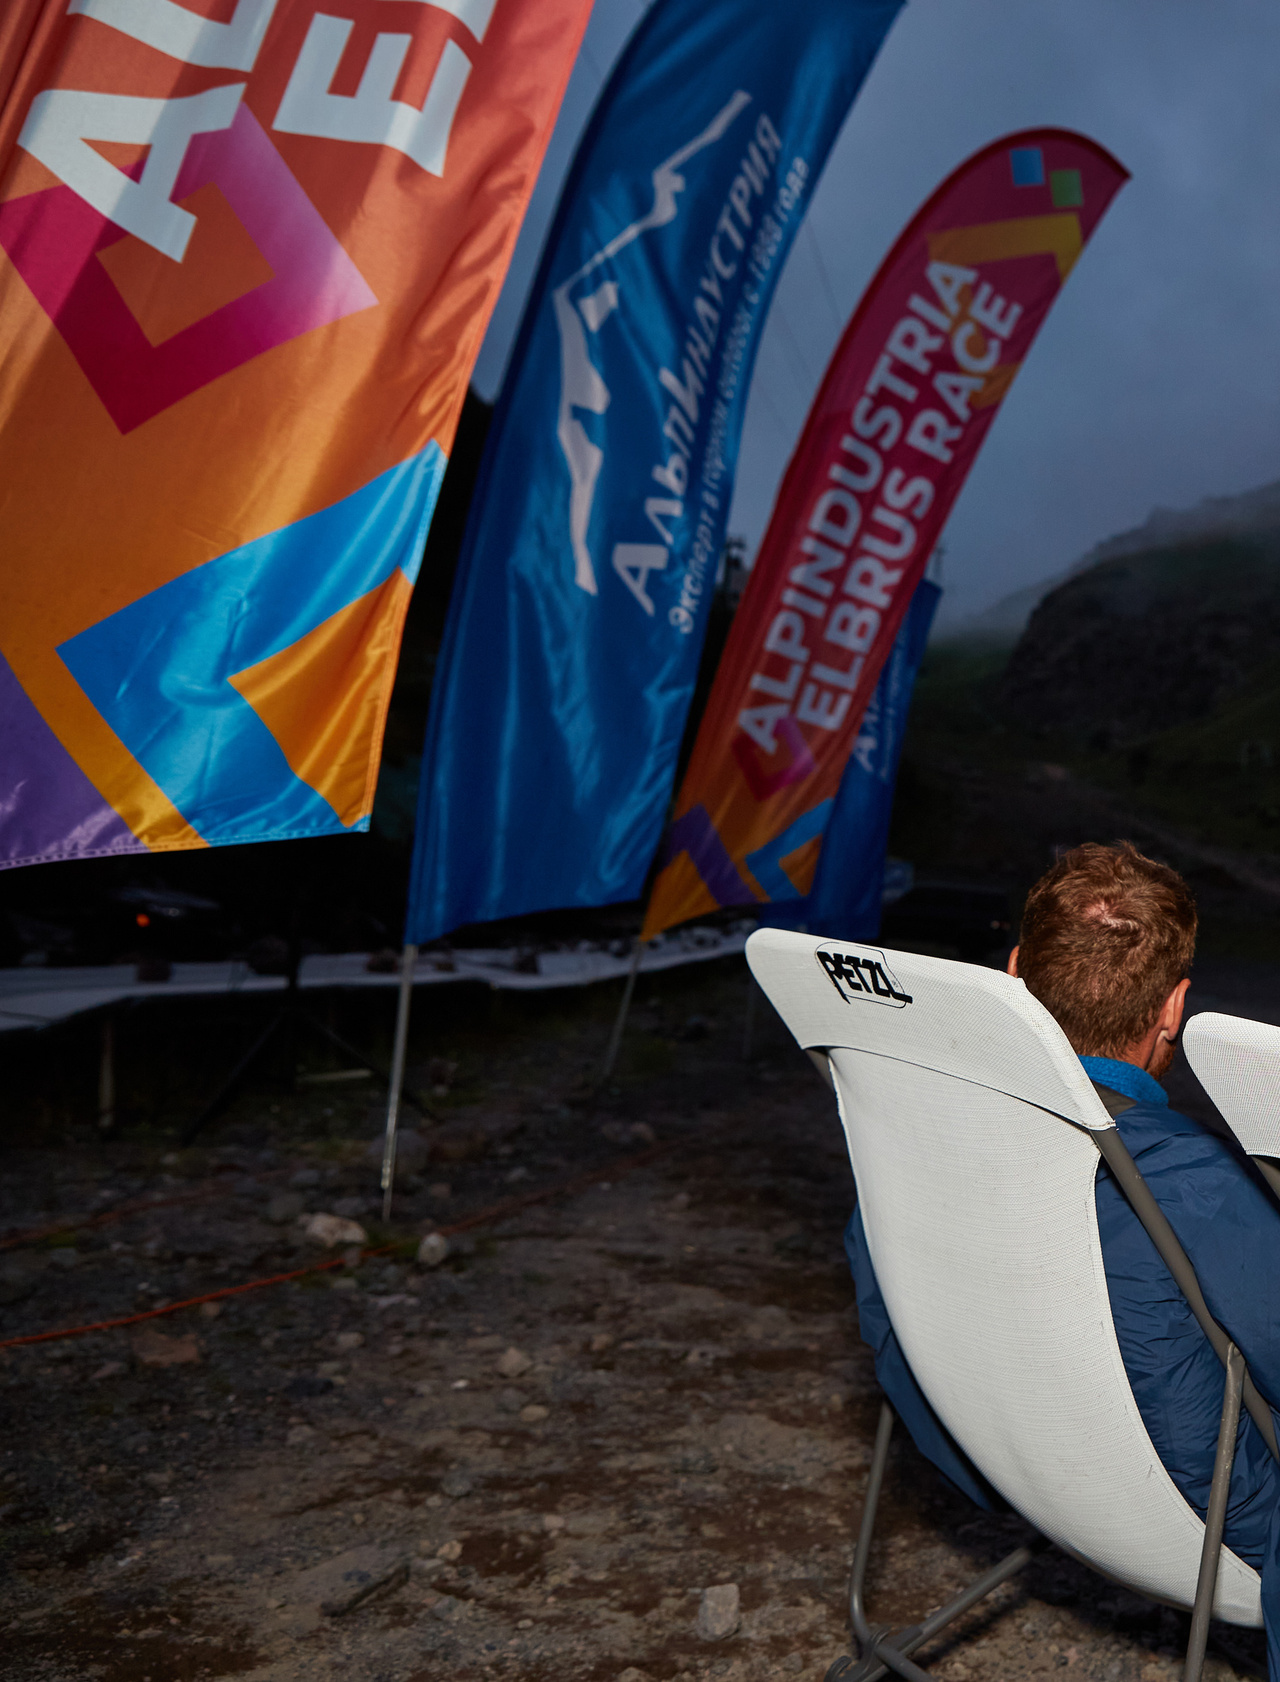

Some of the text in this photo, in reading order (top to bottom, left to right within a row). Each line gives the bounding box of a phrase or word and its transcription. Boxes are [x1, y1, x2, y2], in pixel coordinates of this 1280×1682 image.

[737, 260, 978, 754] ALPINDUSTRIA
[796, 283, 1022, 732] ELBRUS RACE
[816, 951, 913, 1005] PETZL
